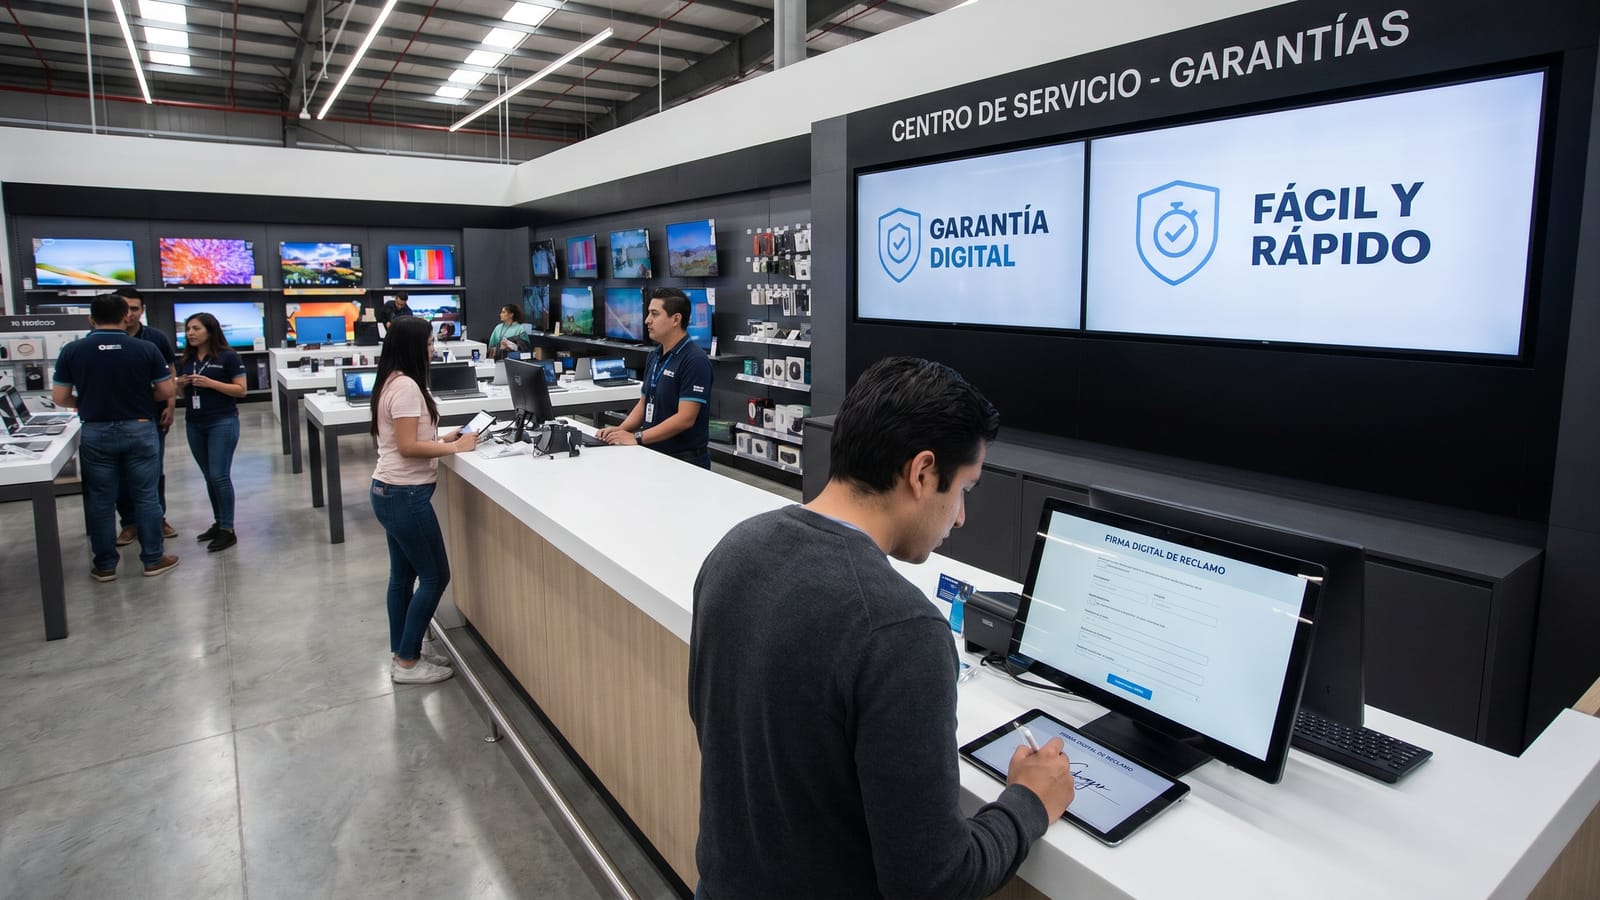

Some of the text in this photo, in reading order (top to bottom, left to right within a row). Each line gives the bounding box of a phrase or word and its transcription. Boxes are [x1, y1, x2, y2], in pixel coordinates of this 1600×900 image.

[891, 105, 973, 142] CENTRO
[978, 96, 1007, 126] DE
[1013, 68, 1142, 119] SERVICIO
[1169, 9, 1409, 88] GARANTÍAS
[929, 203, 1050, 240] GARANTÍA
[1253, 181, 1425, 225] FÁCIL Y
[930, 243, 1016, 269] DIGITAL
[1251, 225, 1432, 267] RÁPIDO
[1104, 533, 1131, 549] FIRMA
[1131, 541, 1165, 559] DIGITAL
[1165, 551, 1179, 562] DE
[1179, 555, 1226, 576] RECLAMO
